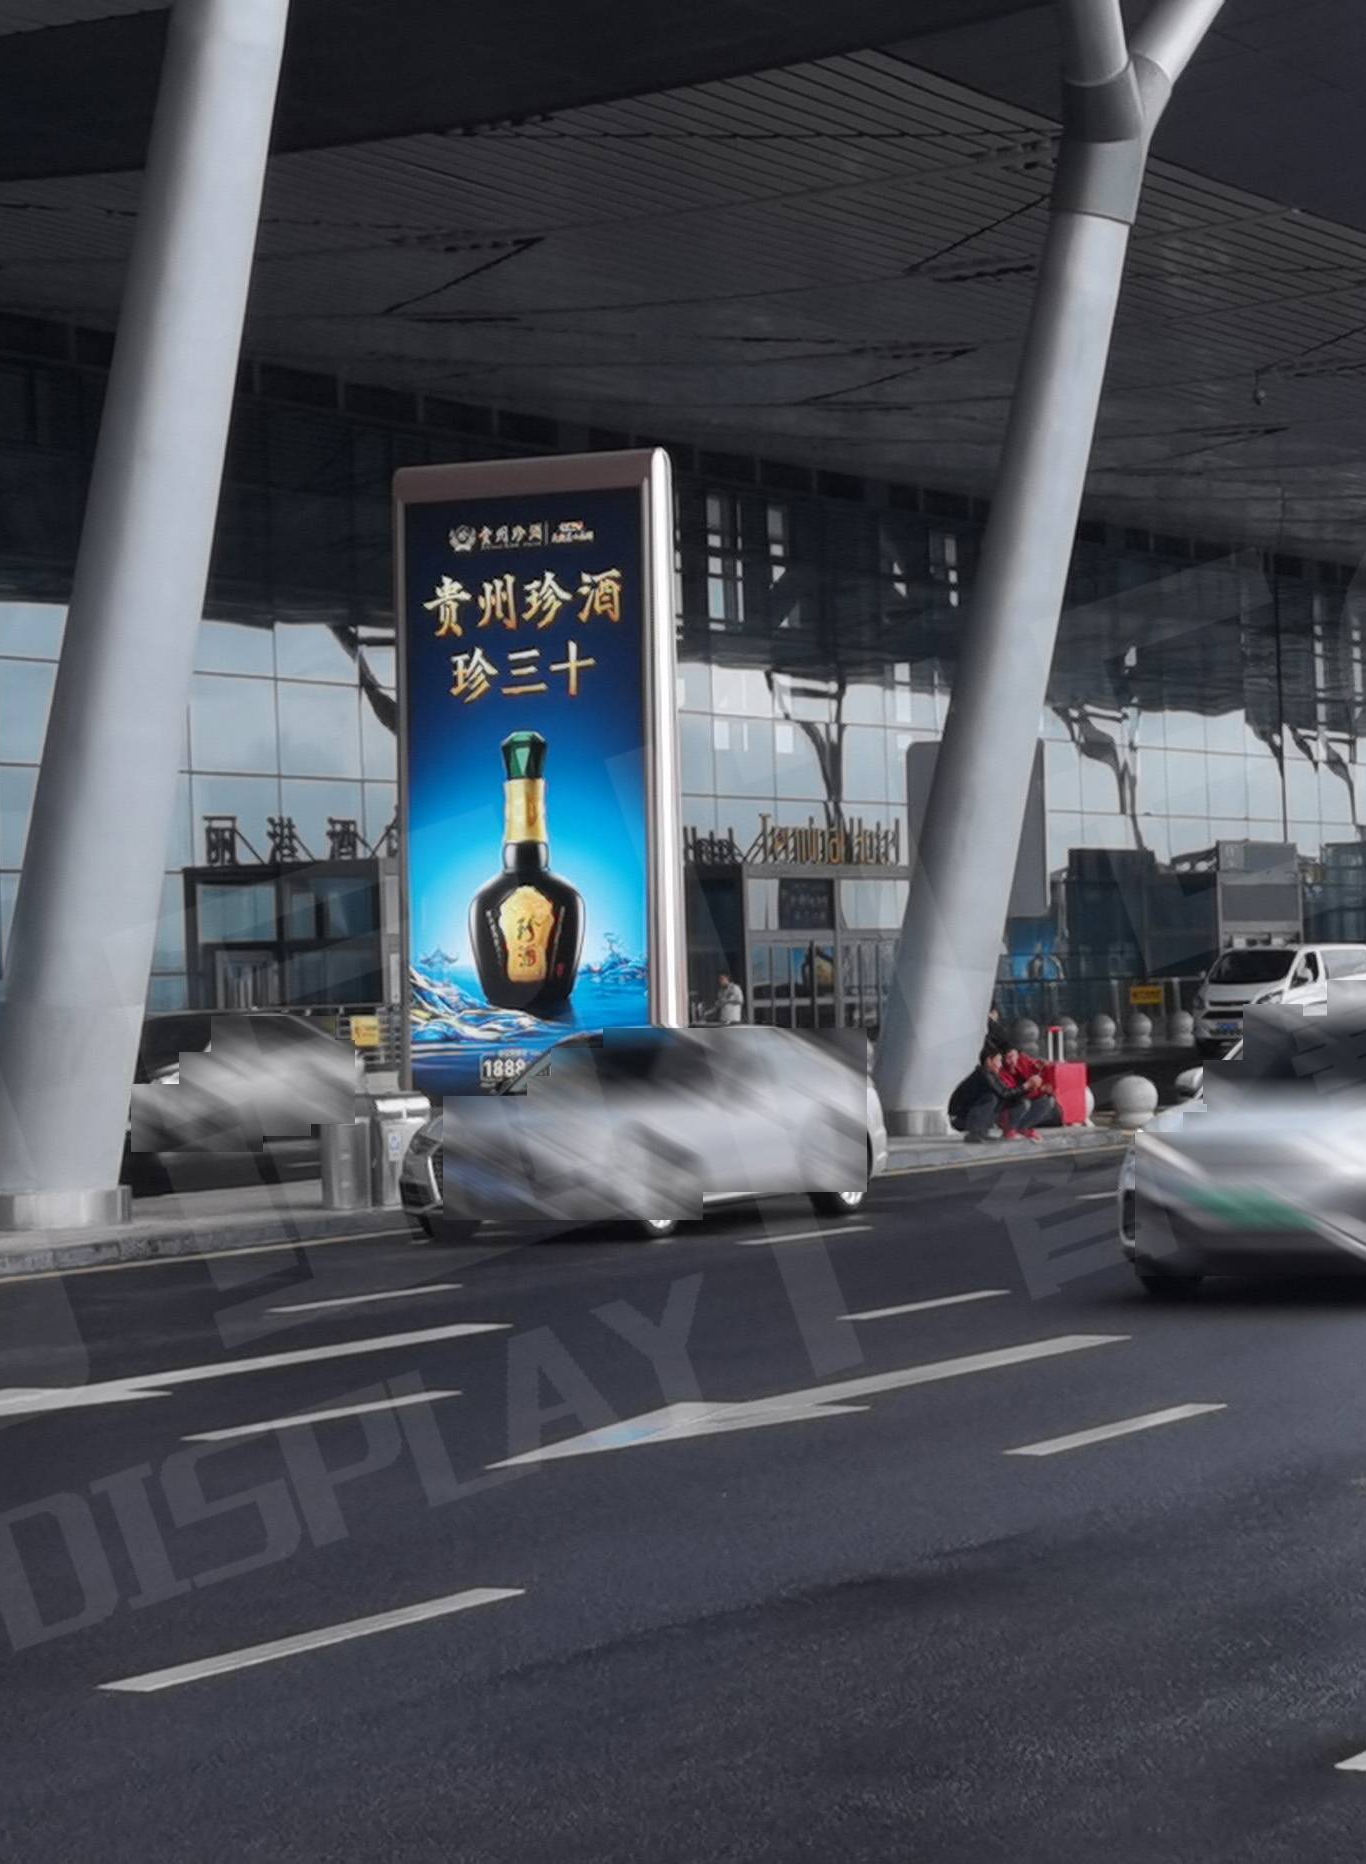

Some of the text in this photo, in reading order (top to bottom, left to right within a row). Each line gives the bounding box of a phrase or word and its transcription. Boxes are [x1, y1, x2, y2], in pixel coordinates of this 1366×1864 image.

[423, 568, 624, 636] 贵州珍酒
[450, 640, 596, 703] 珍三十
